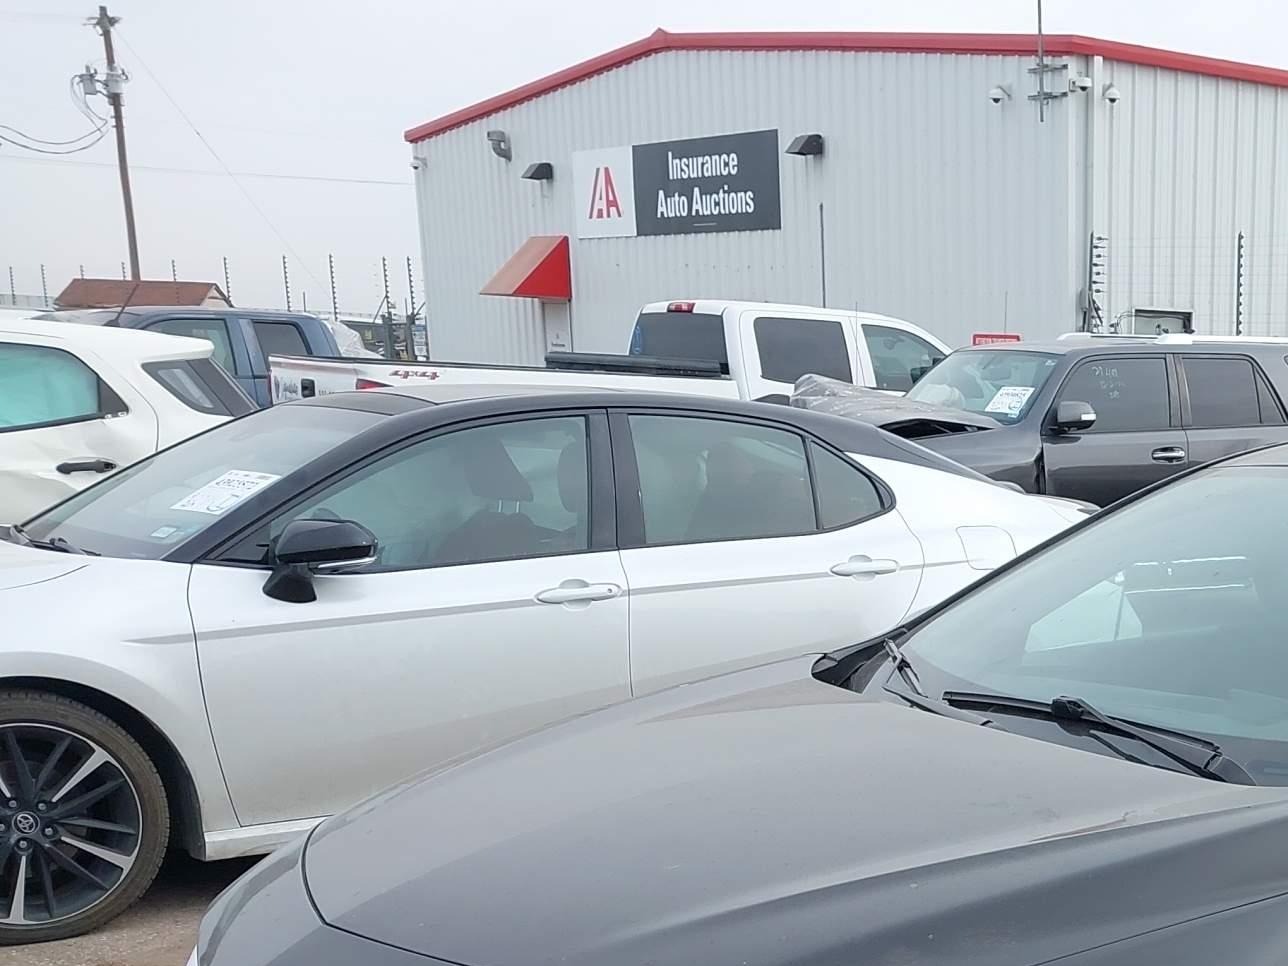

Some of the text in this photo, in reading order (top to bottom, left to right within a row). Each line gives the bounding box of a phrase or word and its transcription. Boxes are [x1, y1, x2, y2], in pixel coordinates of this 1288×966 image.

[667, 151, 738, 180] Insurance
[656, 184, 755, 218] Auto Auctions
